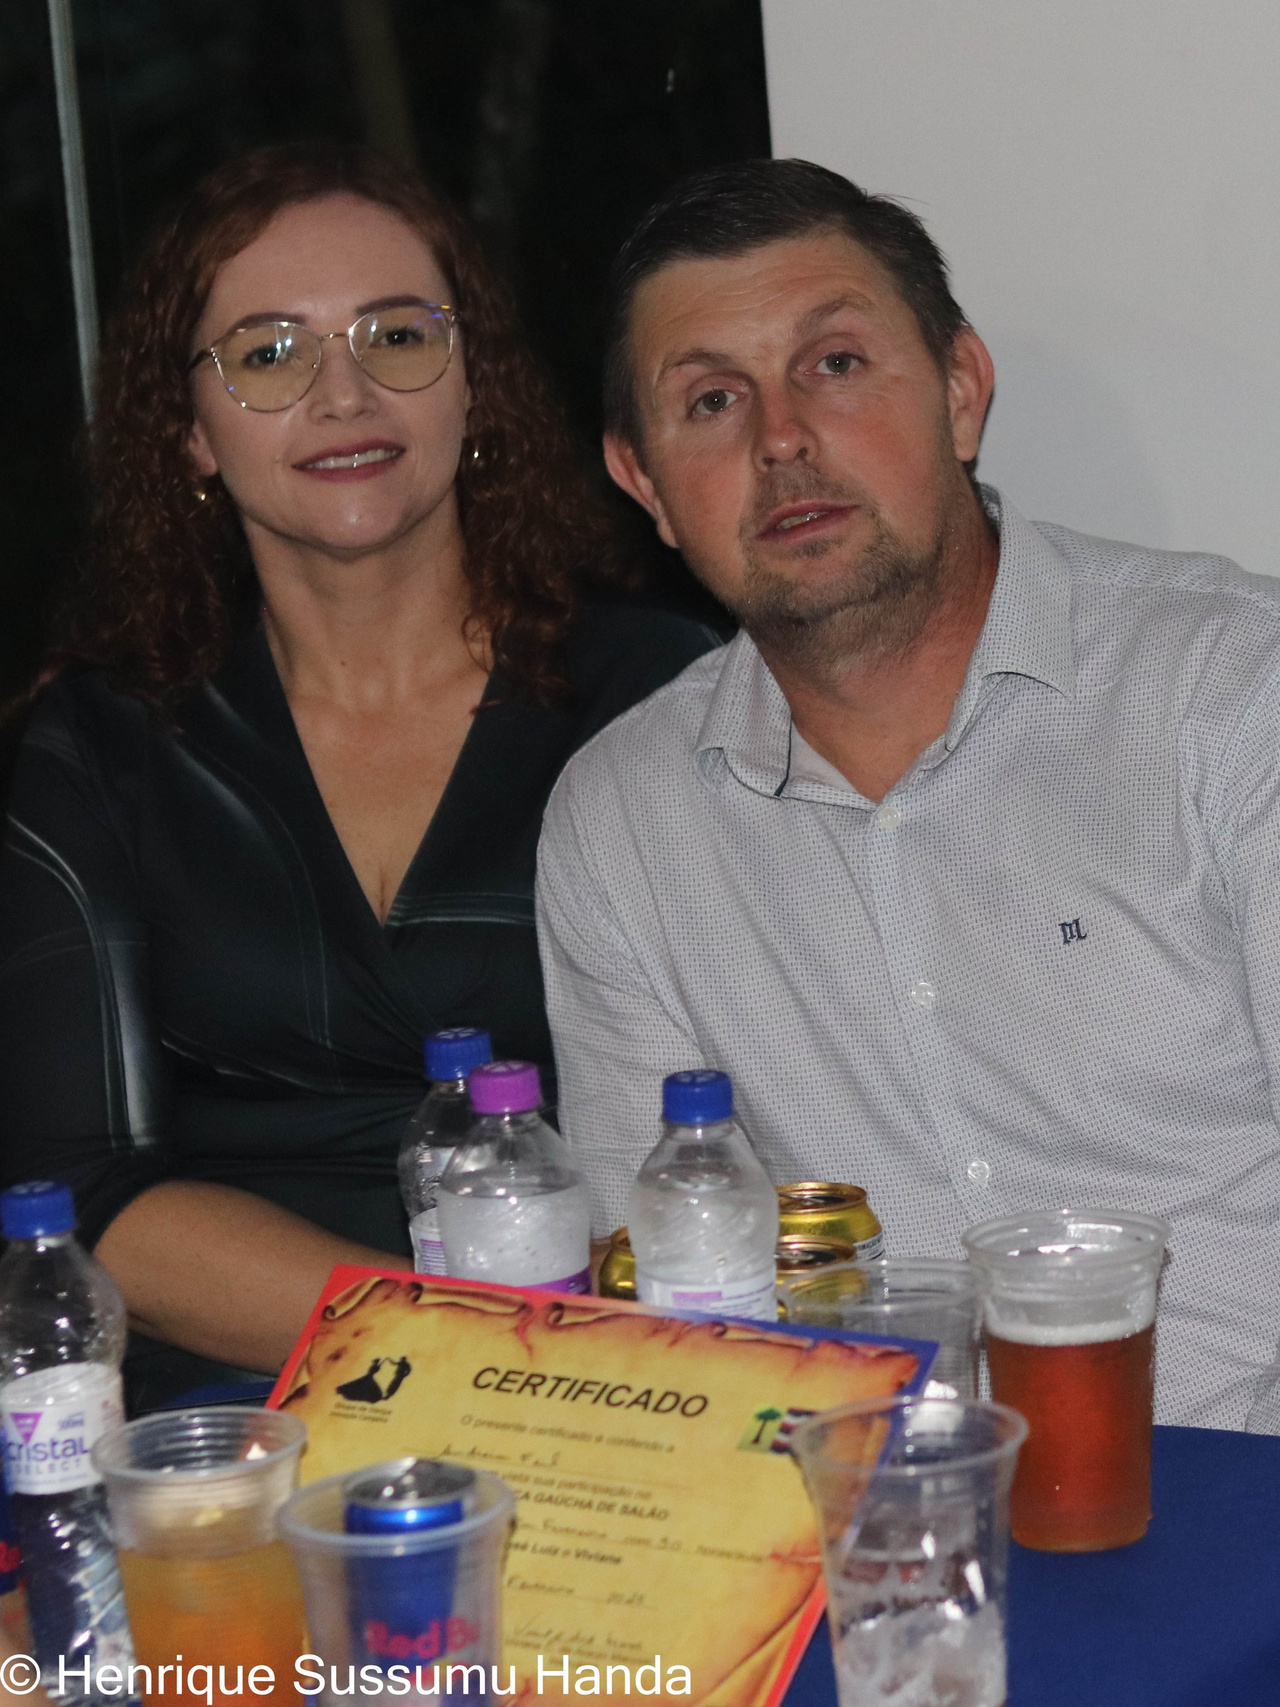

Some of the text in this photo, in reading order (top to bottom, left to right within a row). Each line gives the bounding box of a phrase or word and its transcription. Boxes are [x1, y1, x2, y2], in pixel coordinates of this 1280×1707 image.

[472, 1366, 709, 1418] CERTIFICADO
[460, 1413, 472, 1426] O
[530, 1423, 592, 1443] certificado
[596, 1501, 616, 1514] DE
